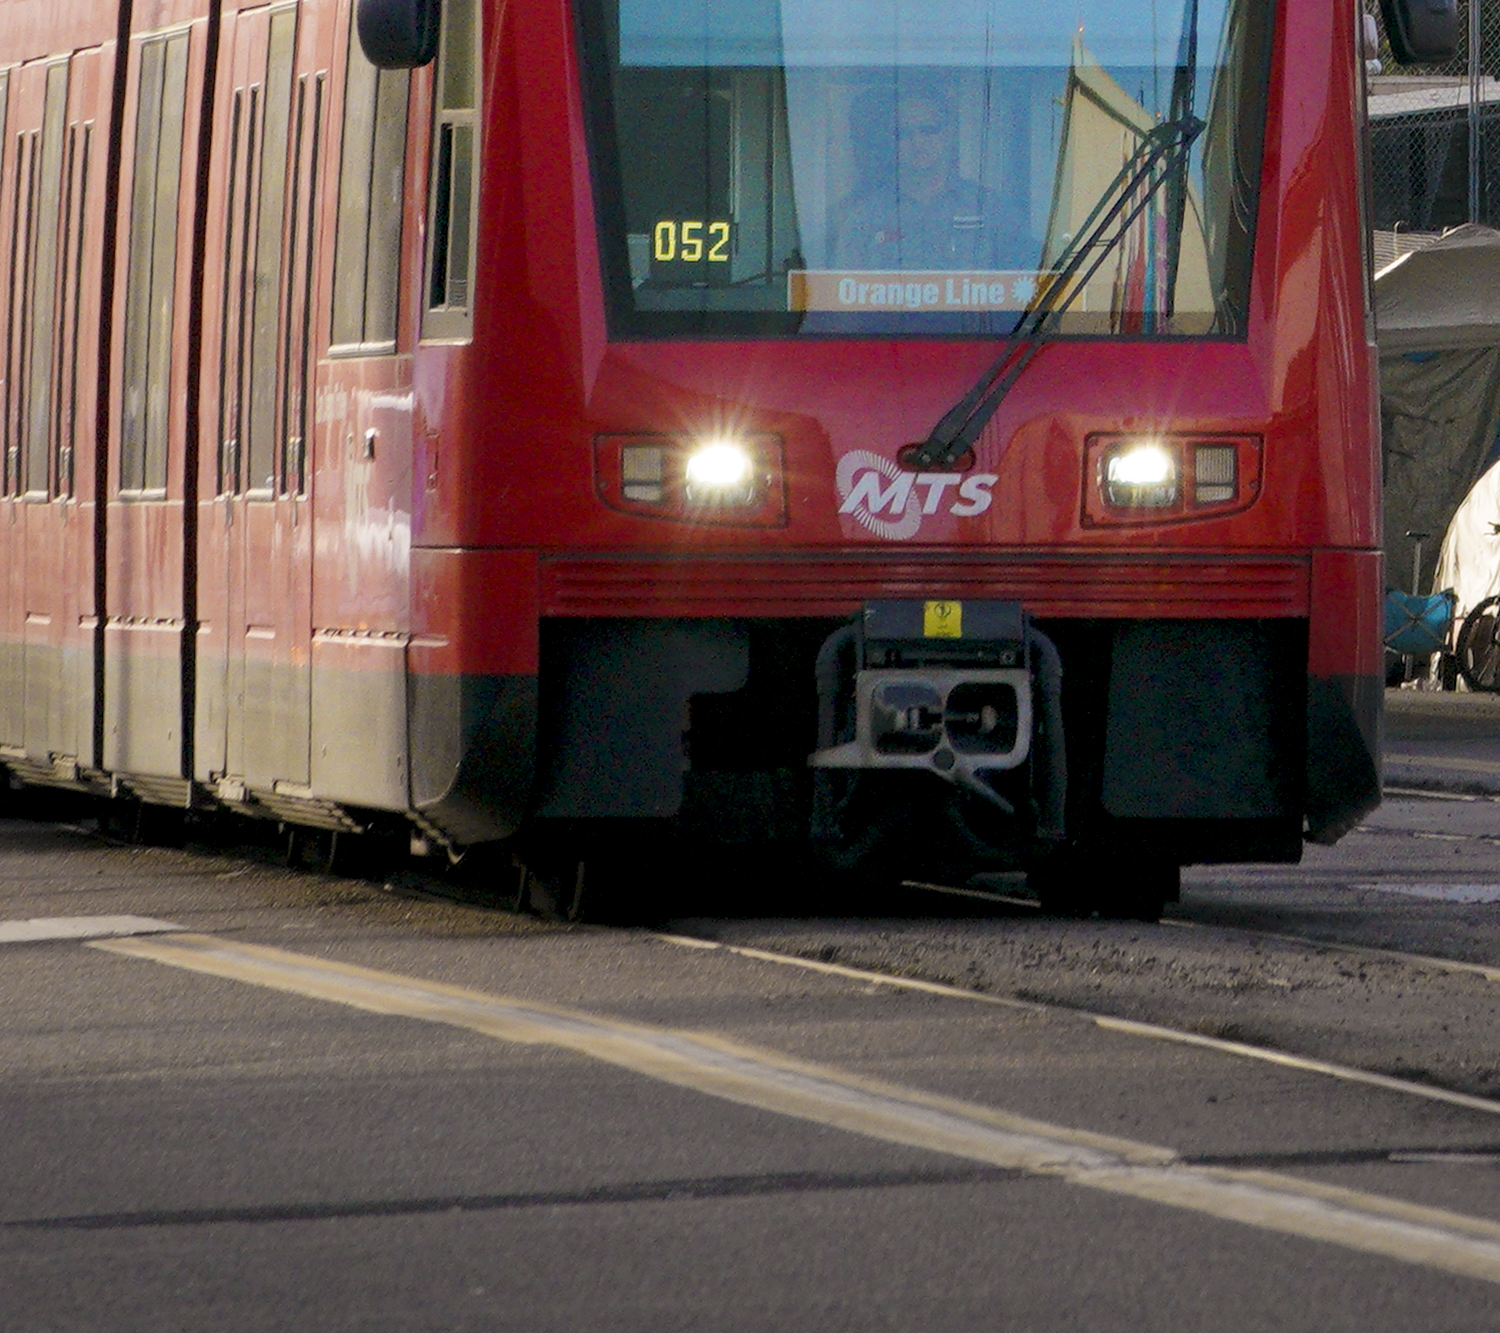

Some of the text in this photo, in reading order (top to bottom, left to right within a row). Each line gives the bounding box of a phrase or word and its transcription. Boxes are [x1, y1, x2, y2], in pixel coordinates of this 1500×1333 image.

[654, 220, 730, 262] 052
[838, 277, 1006, 306] Orange Line
[838, 471, 999, 517] MTS
